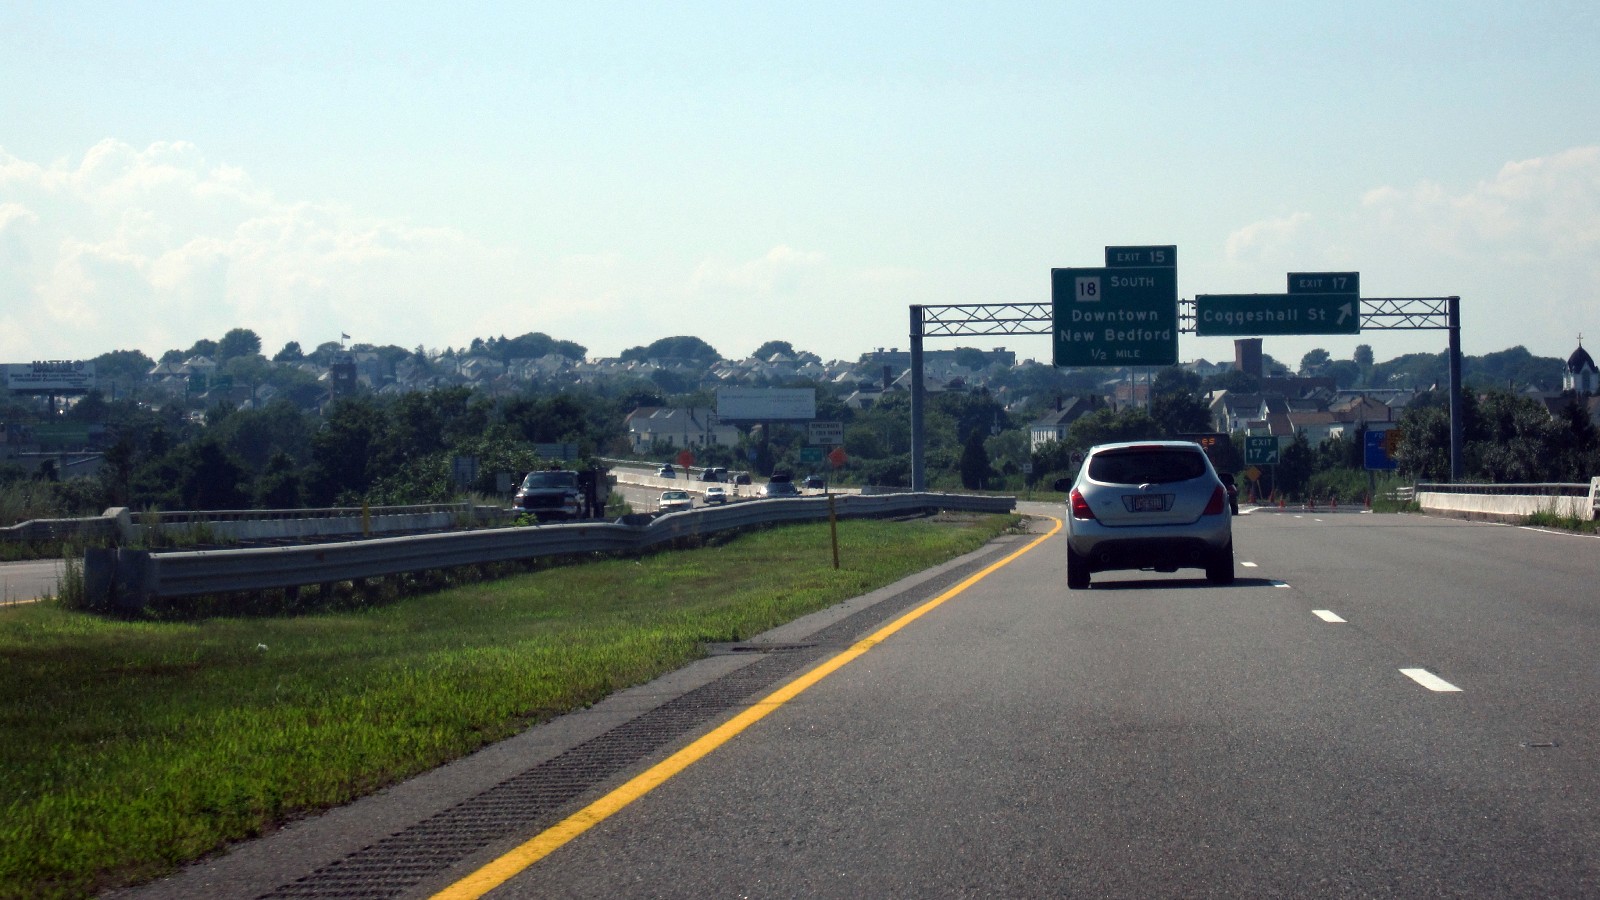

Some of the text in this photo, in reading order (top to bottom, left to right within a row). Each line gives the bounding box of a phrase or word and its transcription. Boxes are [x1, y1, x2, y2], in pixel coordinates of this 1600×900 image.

[1117, 250, 1165, 263] EXIT 15
[1080, 282, 1096, 296] 18
[1299, 277, 1347, 289] EXIT 17
[1072, 309, 1158, 322] Downtown
[1203, 307, 1326, 325] Coggeshall St
[1060, 328, 1171, 342] New Bedford
[1116, 349, 1141, 358] MILE
[1251, 438, 1271, 446] EXIT
[1249, 448, 1262, 459] 17
